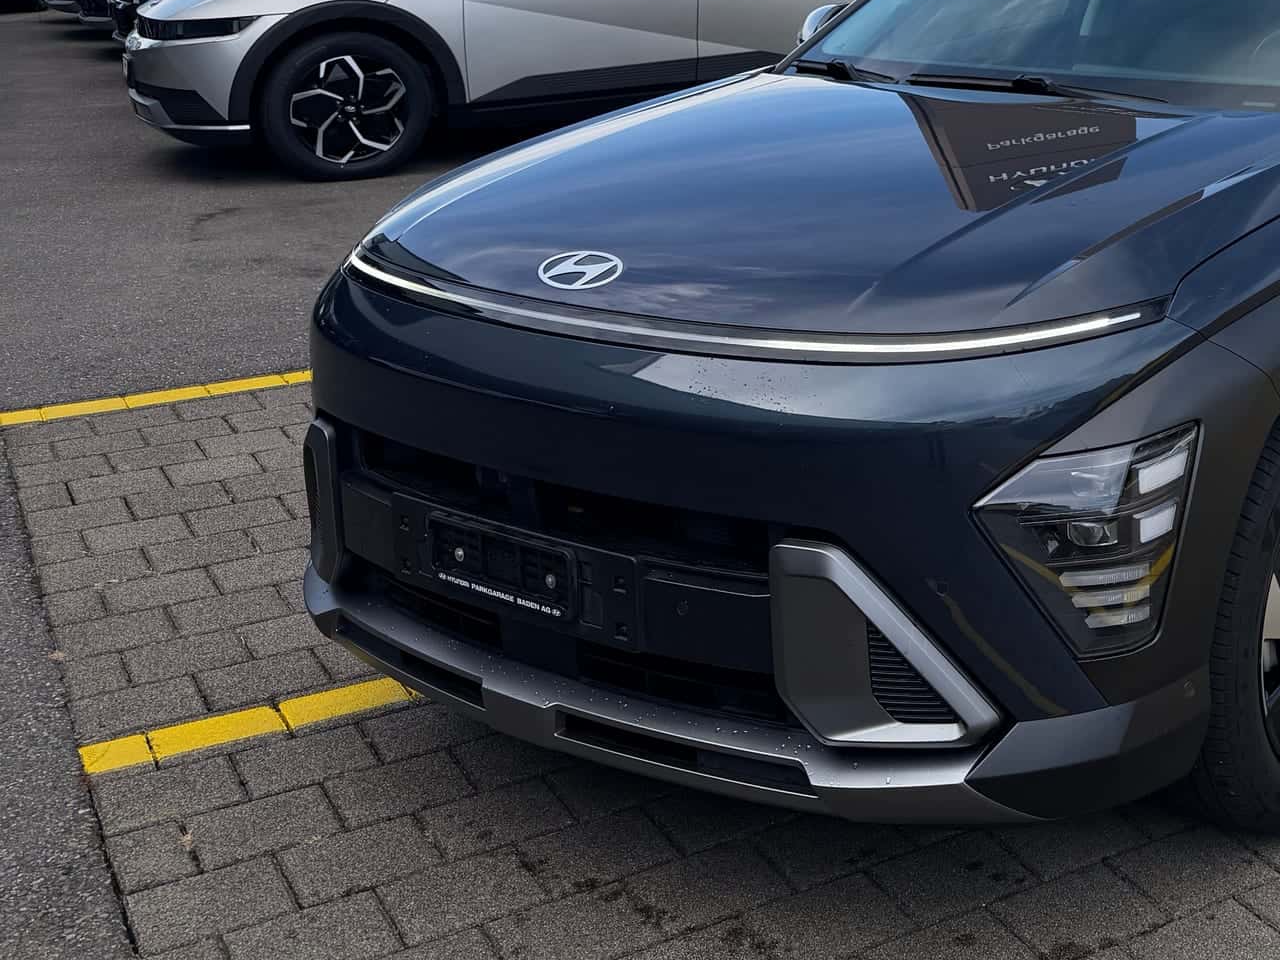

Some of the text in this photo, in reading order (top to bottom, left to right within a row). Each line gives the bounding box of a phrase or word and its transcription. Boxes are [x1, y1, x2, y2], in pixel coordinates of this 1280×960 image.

[471, 582, 515, 603] PARKGARAGE
[516, 597, 540, 610] BADEN
[541, 605, 551, 614] AG
